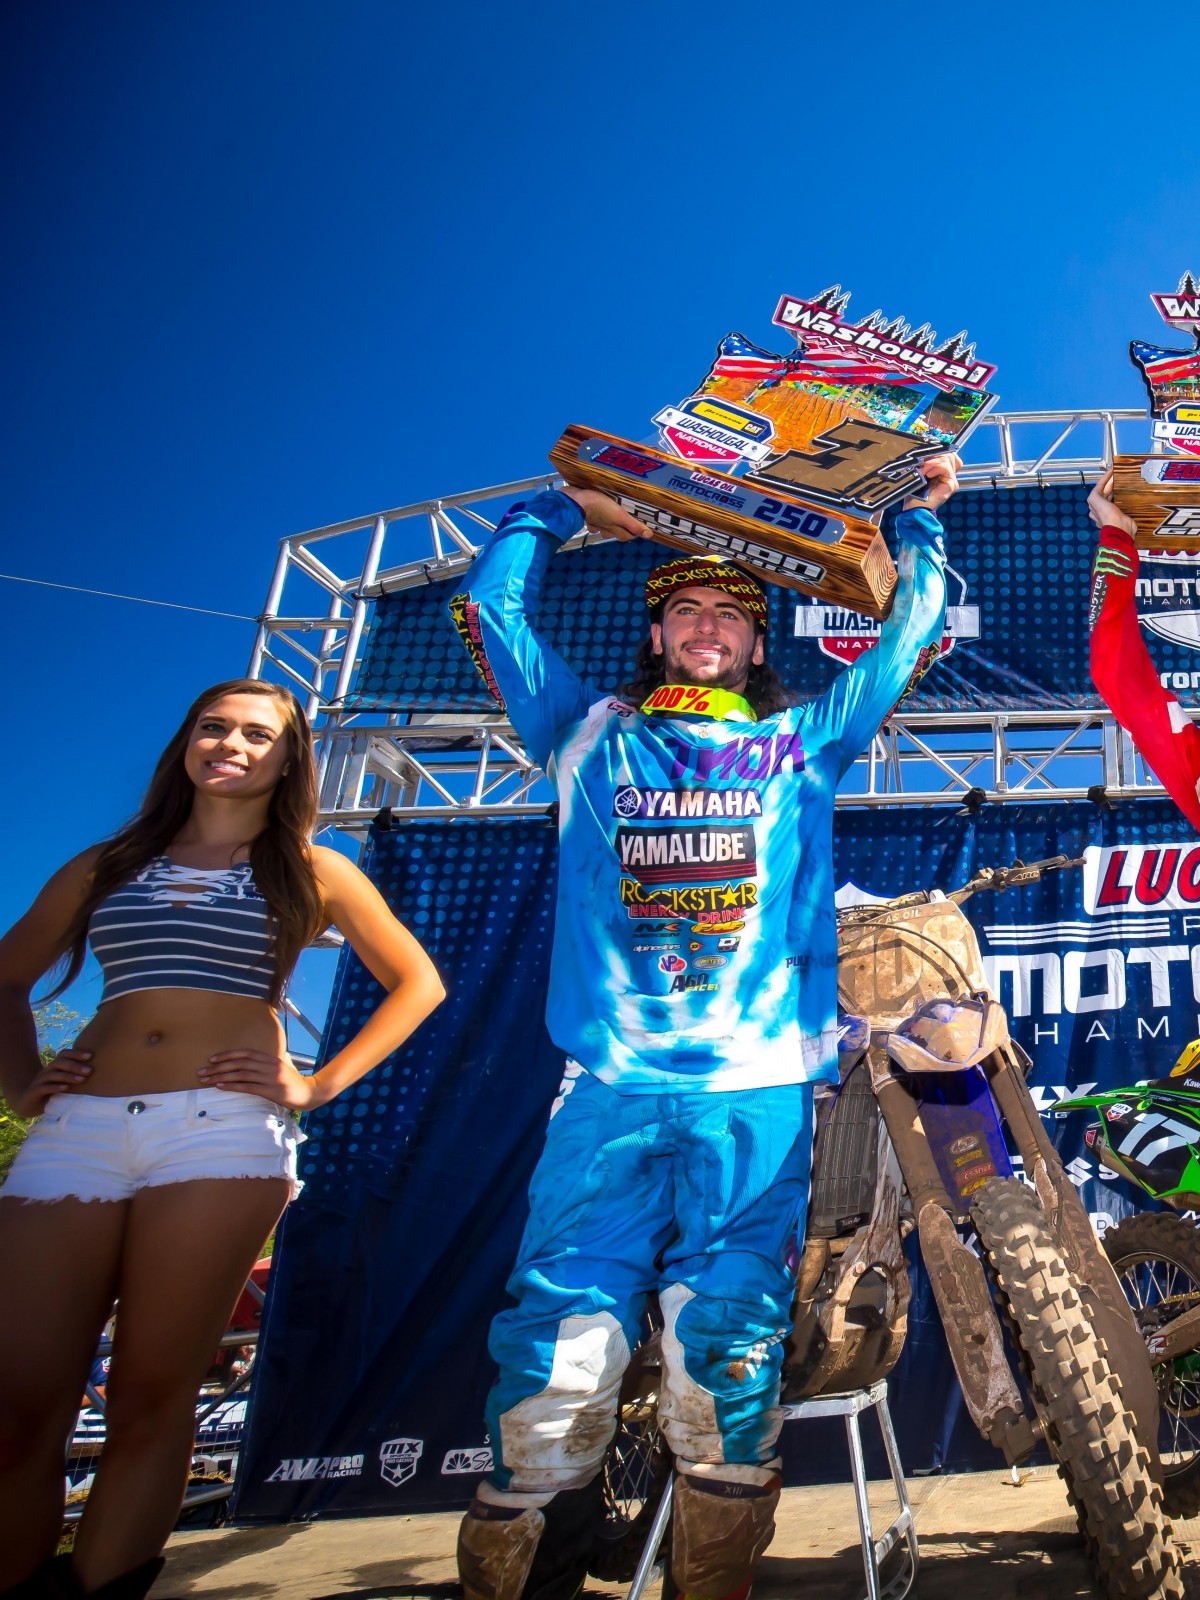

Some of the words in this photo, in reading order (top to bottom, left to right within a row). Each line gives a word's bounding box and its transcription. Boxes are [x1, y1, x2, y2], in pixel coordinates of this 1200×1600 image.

[781, 300, 989, 384] Washougal
[676, 417, 750, 451] WASHOUGAL
[743, 423, 763, 434] CAT
[675, 431, 727, 457] NATIONAL
[597, 448, 663, 476] 2017
[667, 478, 746, 509] MOTOCROSS
[692, 473, 719, 488] LUCAS
[719, 481, 736, 493] OIL
[753, 498, 829, 538] 250
[1088, 574, 1106, 632] MONSTER
[649, 686, 713, 713] 100%
[645, 791, 762, 817] YAMAHA
[620, 832, 746, 867] YAMALUBE
[697, 907, 747, 925] DRINK
[902, 909, 920, 920] OIL
[661, 955, 678, 973] VP
[264, 1457, 331, 1483] AMA
[327, 1454, 364, 1471] PRO
[327, 1468, 362, 1478] RACING
